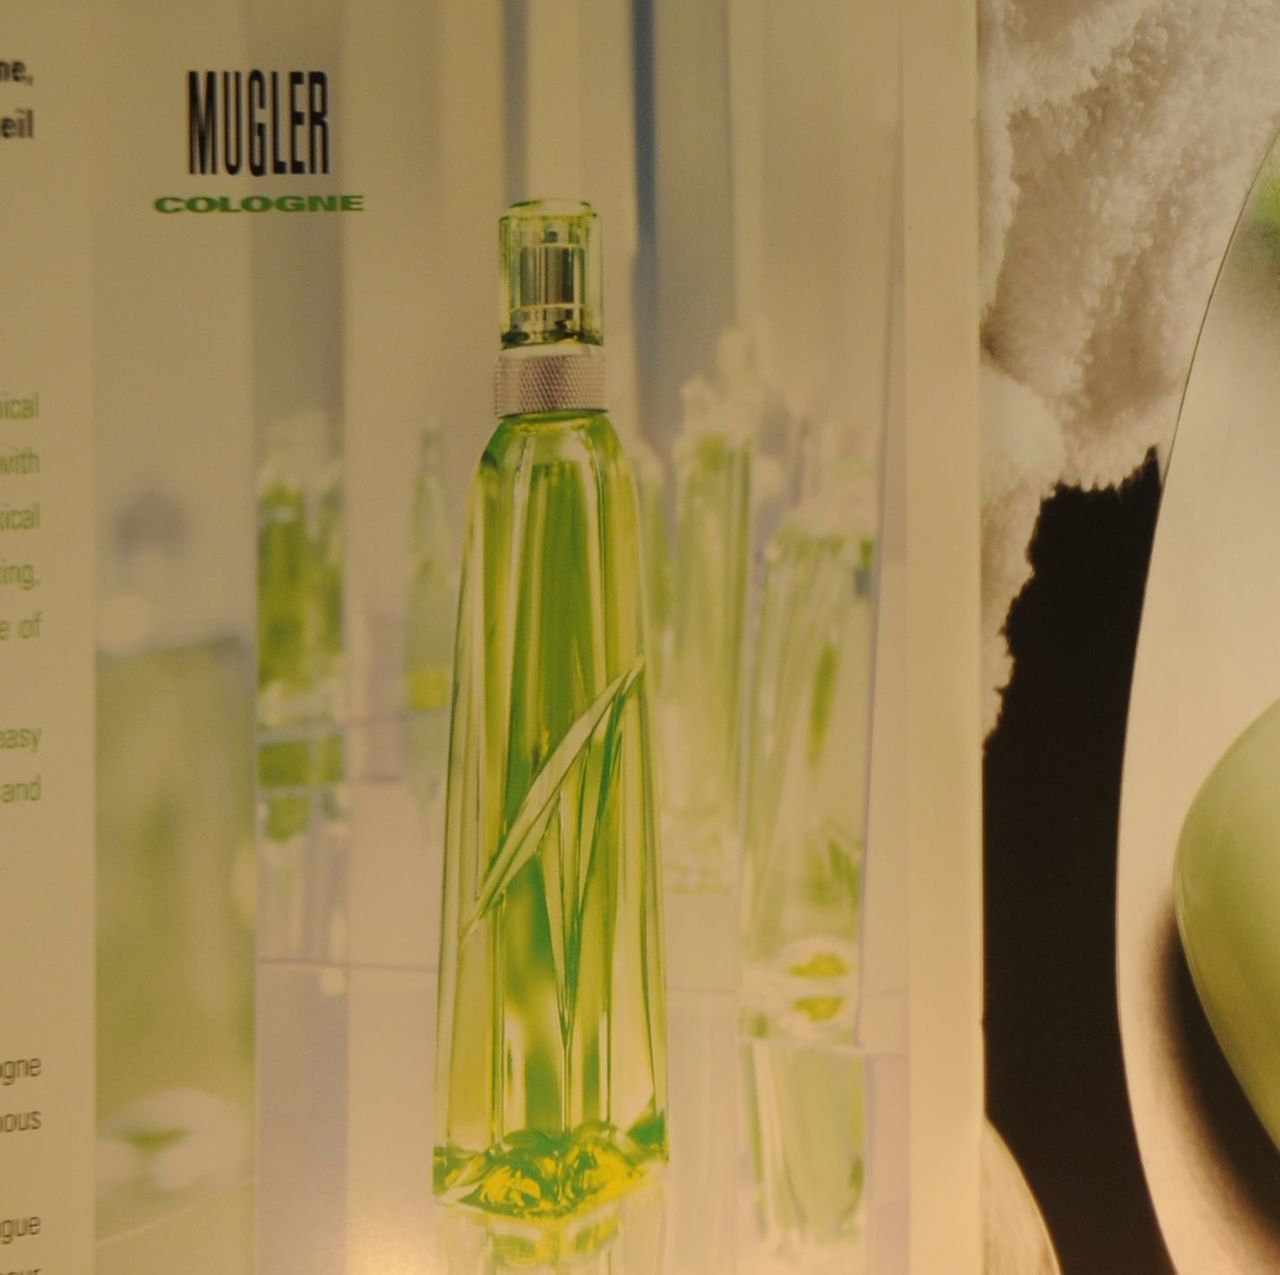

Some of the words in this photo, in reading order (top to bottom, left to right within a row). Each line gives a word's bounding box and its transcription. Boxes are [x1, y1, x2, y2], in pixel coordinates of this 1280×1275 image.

[187, 69, 330, 176] MUGLER
[153, 194, 365, 213] COLOGNE
[0, 391, 40, 419] ical
[0, 1058, 42, 1086] gne
[0, 1111, 42, 1132] ous
